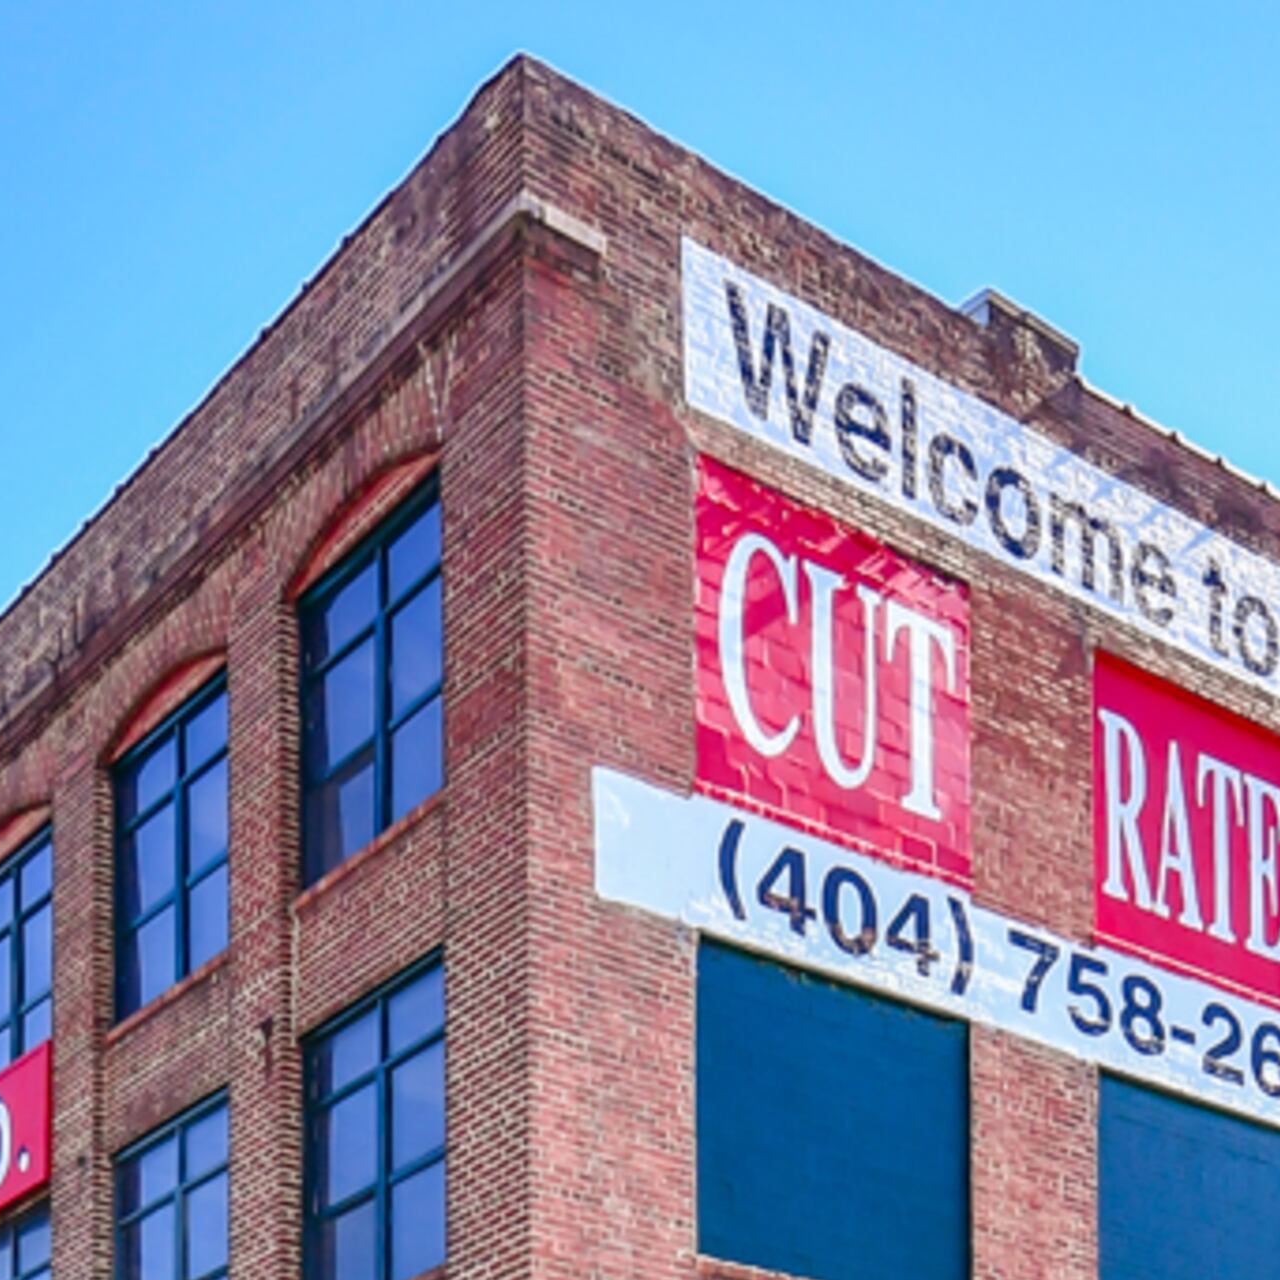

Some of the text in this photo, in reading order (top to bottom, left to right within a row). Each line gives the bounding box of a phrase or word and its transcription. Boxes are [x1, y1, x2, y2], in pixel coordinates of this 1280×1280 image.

[723, 278, 1178, 628] Welcome
[1201, 556, 1280, 678] to
[717, 531, 958, 822] CUT
[719, 817, 975, 995] (404)
